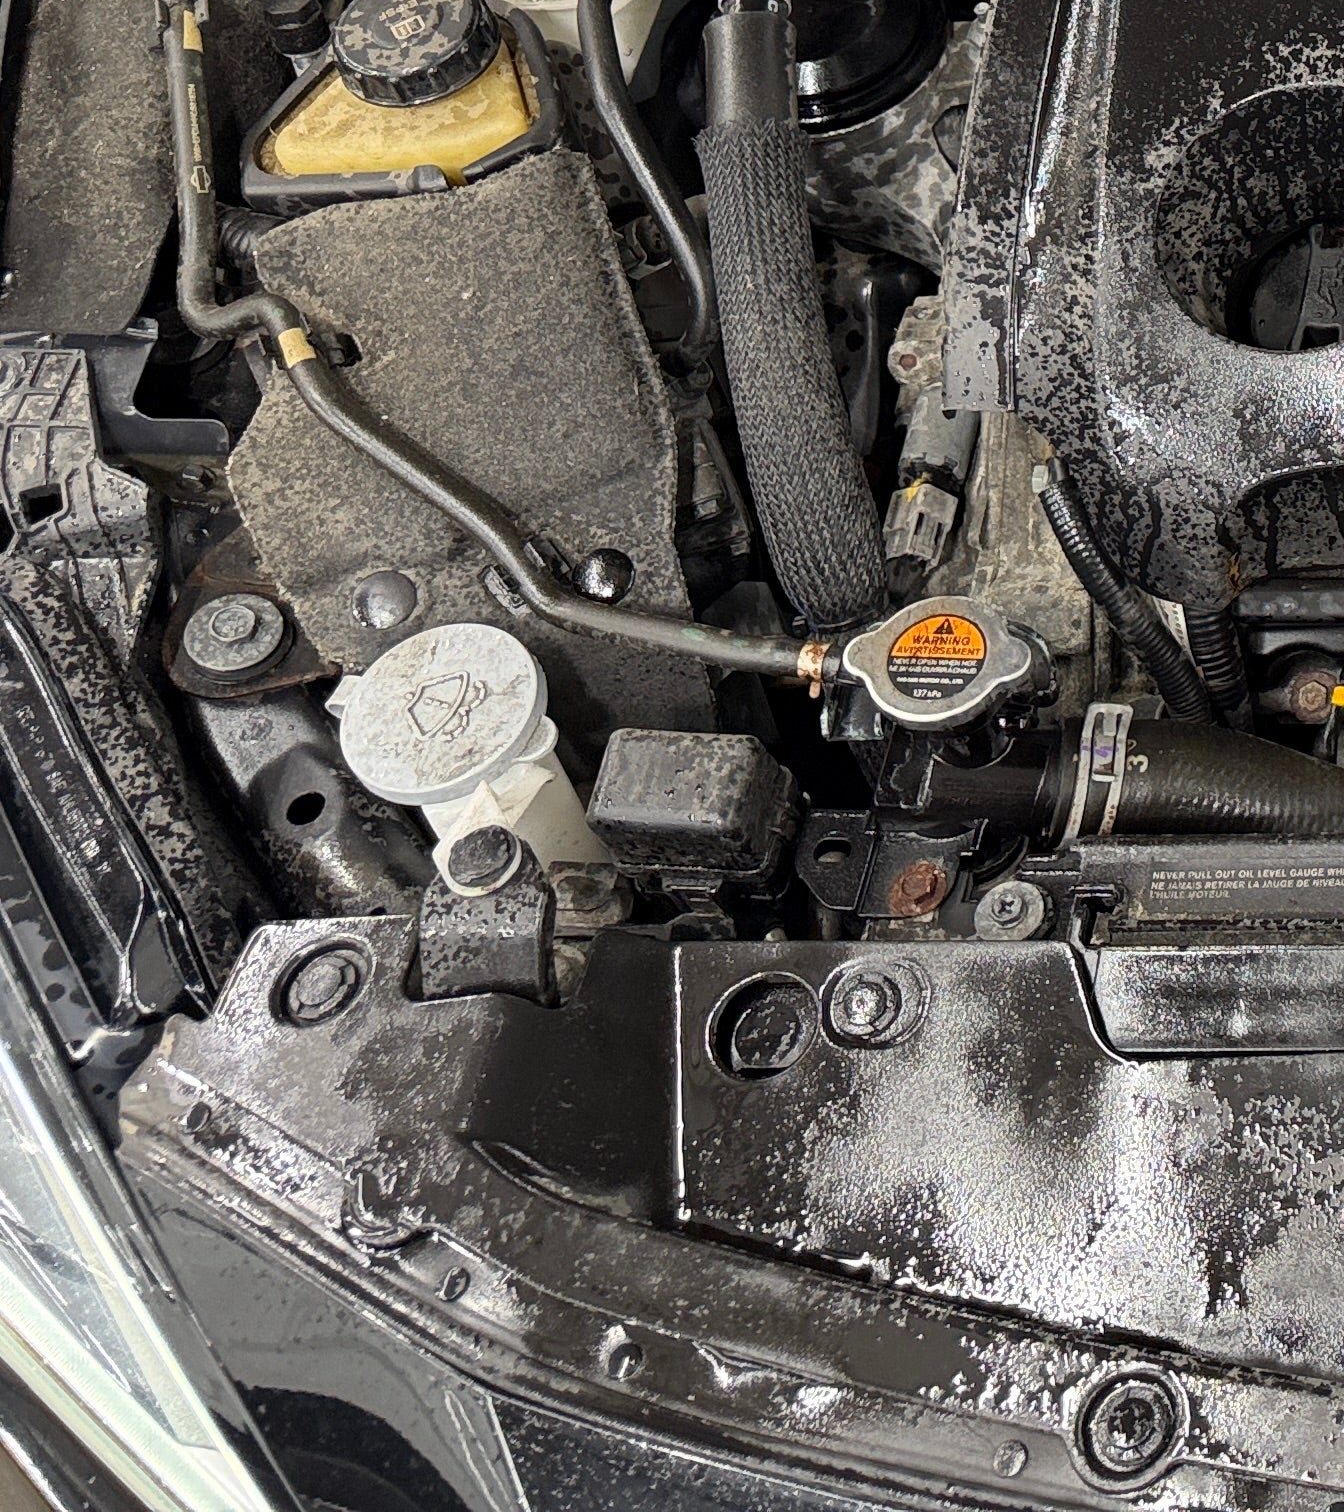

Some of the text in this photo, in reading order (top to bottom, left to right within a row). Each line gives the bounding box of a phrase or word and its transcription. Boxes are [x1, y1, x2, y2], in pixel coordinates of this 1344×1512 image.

[913, 636, 970, 646] WARNING
[1152, 871, 1185, 880] NEVER
[1188, 871, 1212, 879] PULL
[1215, 870, 1236, 878] OUT
[1238, 870, 1253, 878] OIL
[1258, 869, 1286, 878] LEVEL
[1290, 868, 1325, 877] GAUGE
[1167, 881, 1202, 890] JAMAIS
[1204, 881, 1245, 889] RETIRER
[1248, 880, 1260, 888] LA
[1262, 880, 1294, 888] JAUGE
[1296, 879, 1310, 888] DE
